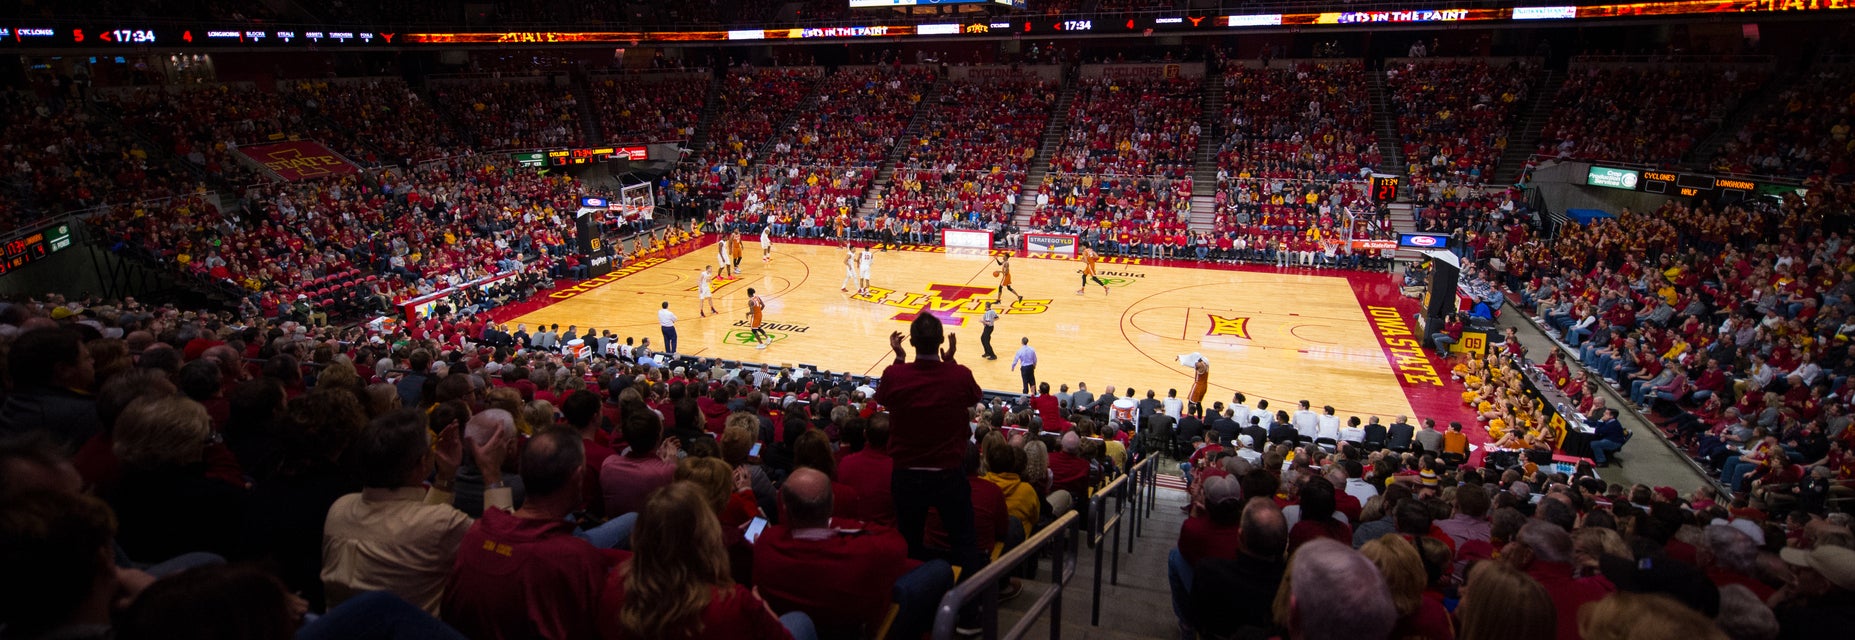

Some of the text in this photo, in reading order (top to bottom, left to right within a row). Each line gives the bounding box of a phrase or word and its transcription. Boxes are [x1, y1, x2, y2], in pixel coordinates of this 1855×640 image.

[1372, 12, 1389, 21] IN
[1392, 11, 1420, 21] THE
[1422, 10, 1469, 20] PAINT
[1025, 21, 1032, 32] 5
[1064, 20, 1092, 31] 17:34
[1126, 19, 1134, 29] 4
[17, 28, 54, 36] CYCLONES
[73, 29, 84, 42] 5
[113, 29, 155, 42] 17:34
[837, 27, 858, 36] THE
[859, 25, 888, 36] PAINT
[182, 30, 193, 43] 4
[968, 68, 1023, 78] CYCLONES
[263, 155, 343, 172] STATE
[1588, 172, 1622, 182] Production
[1644, 172, 1676, 182] CYCLONES
[1715, 179, 1755, 190] LONGHORNS
[1379, 185, 1396, 200] 27
[1680, 187, 1698, 197] HALF
[549, 257, 668, 299] CYCLONES
[850, 285, 1054, 315] STATE
[1367, 304, 1445, 387] IOWA STATE
